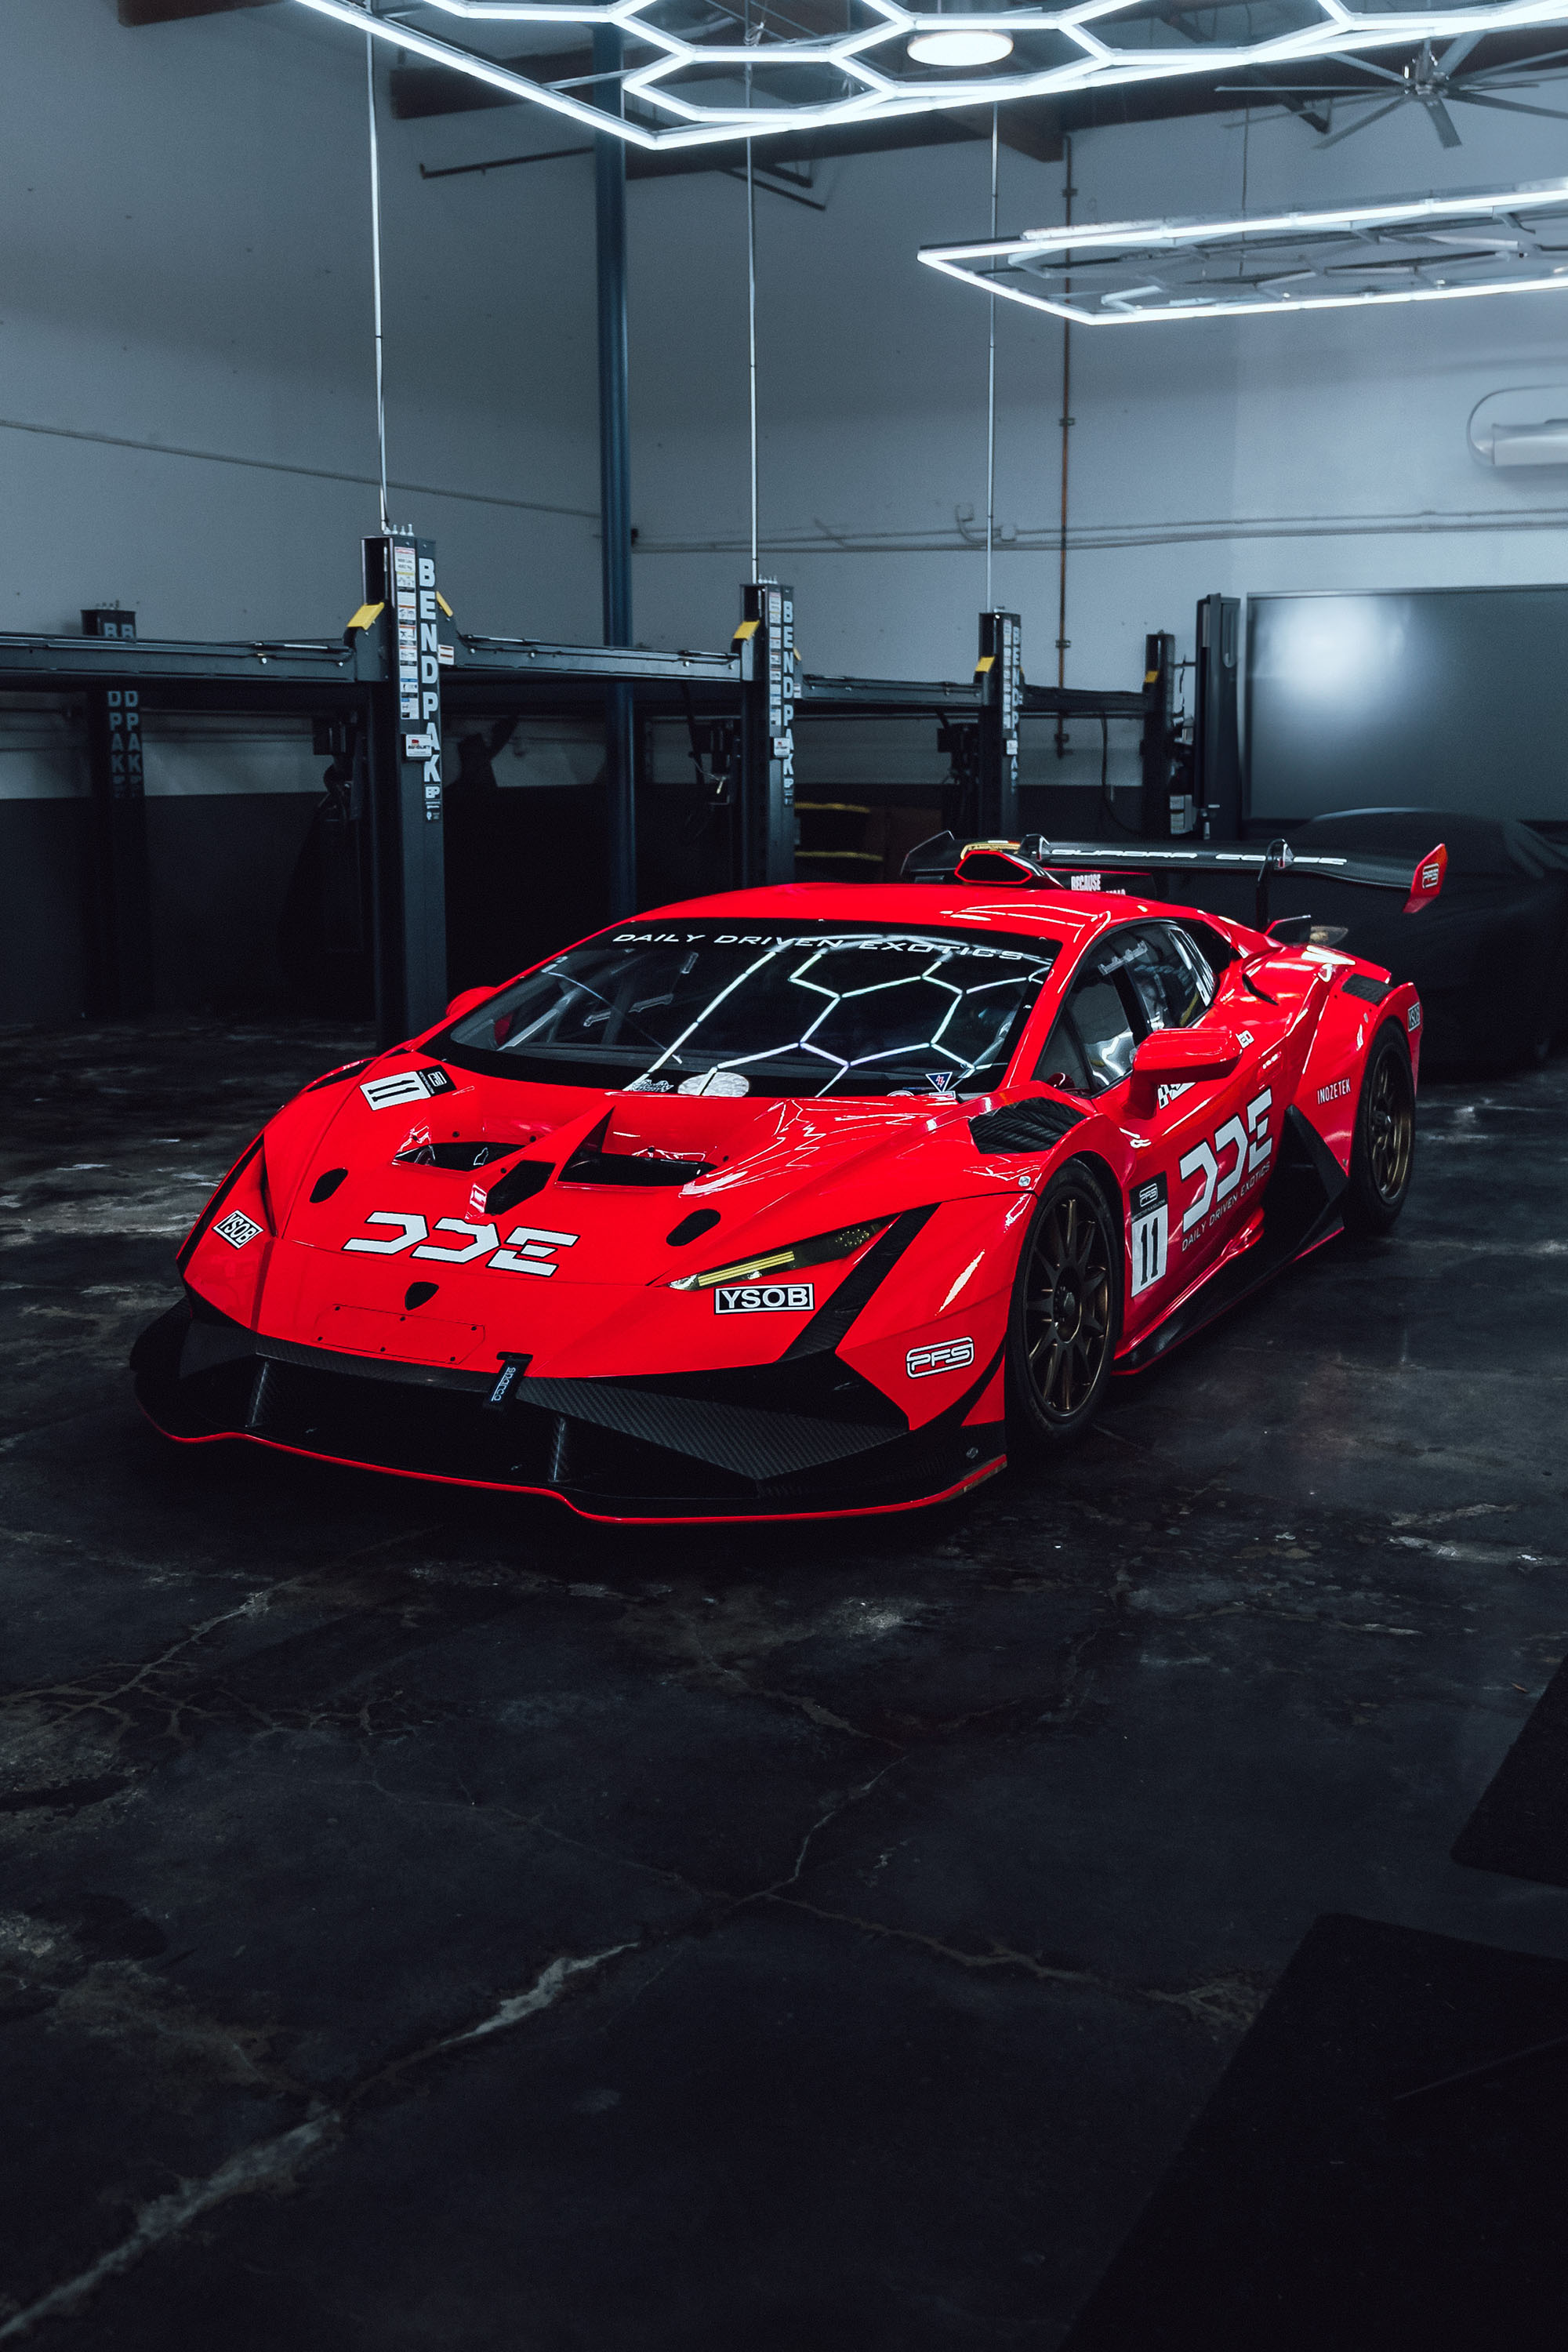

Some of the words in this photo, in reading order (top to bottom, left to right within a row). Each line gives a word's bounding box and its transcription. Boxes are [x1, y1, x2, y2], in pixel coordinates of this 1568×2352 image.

[419, 557, 441, 782] BENDPAK
[1071, 873, 1102, 891] BECAUSE
[612, 934, 706, 942] DAILY
[713, 935, 844, 949] DRIVEN
[858, 941, 1024, 960] EXOTICS
[367, 1080, 420, 1102] 11
[1317, 1078, 1351, 1105] INOZETEK
[1182, 1220, 1207, 1252] DAILY
[1209, 1192, 1238, 1226] DRIVEN
[1240, 1160, 1270, 1196] EXOTICS
[220, 1214, 257, 1243] YSOB
[1141, 1217, 1159, 1287] 11
[720, 1287, 808, 1308] YSOB
[907, 1344, 973, 1373] PFS
[492, 1367, 516, 1402] sparco
